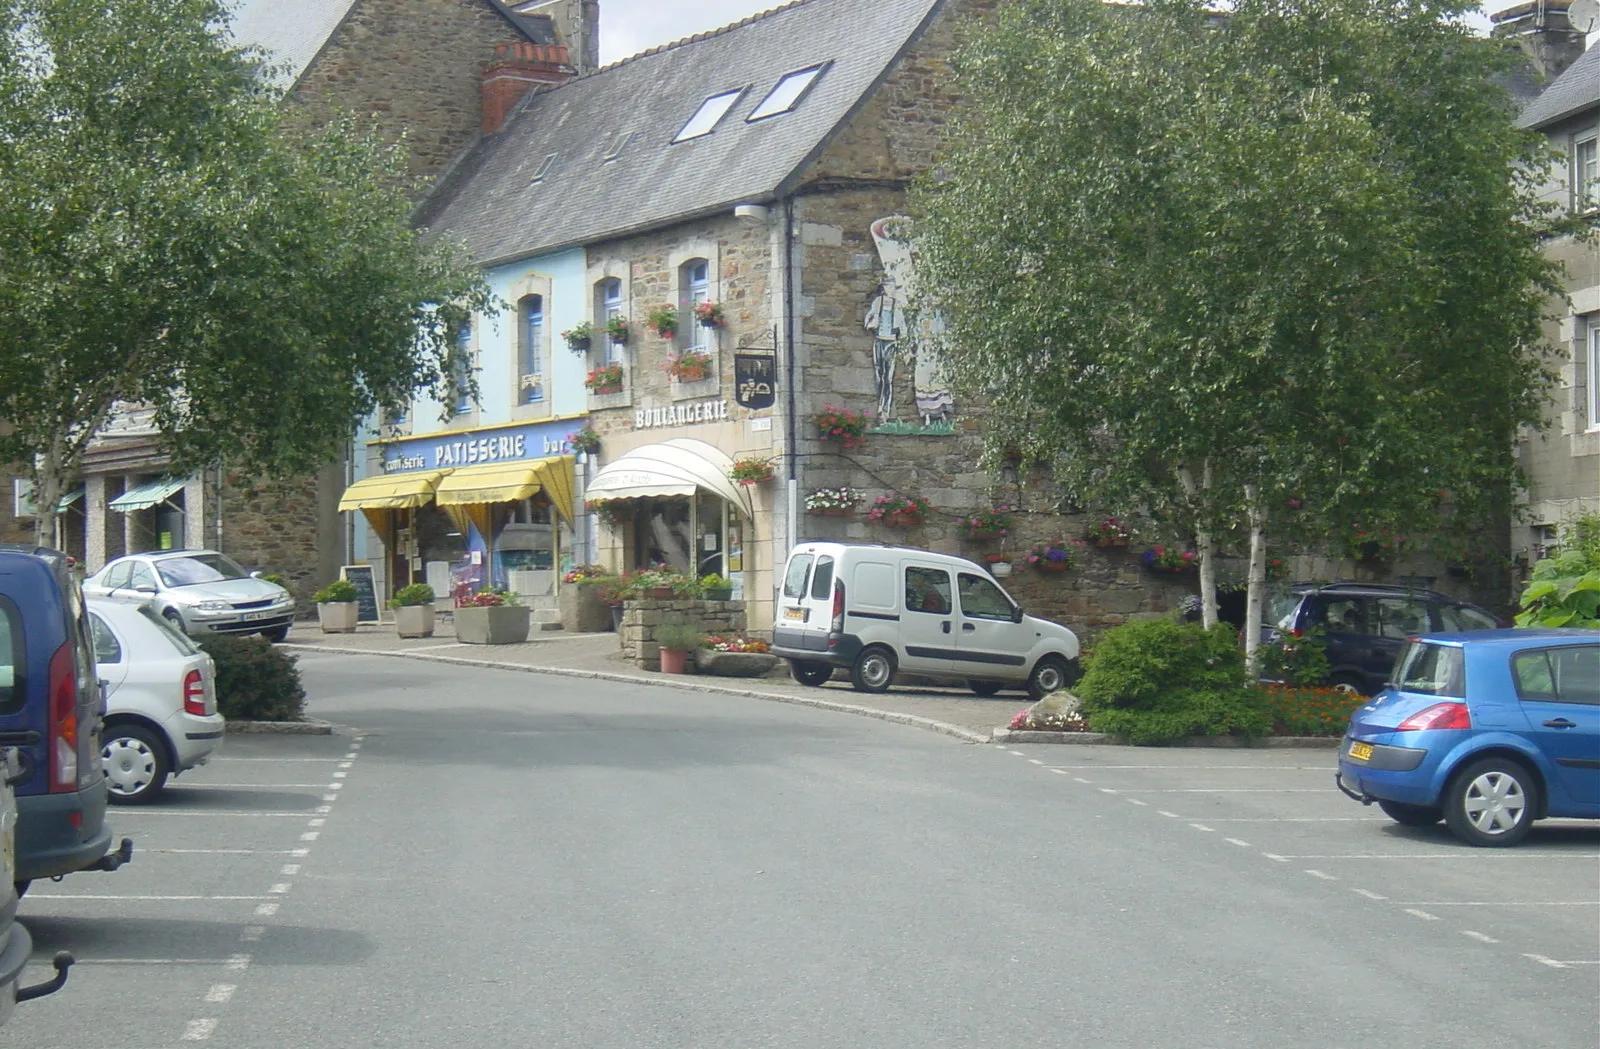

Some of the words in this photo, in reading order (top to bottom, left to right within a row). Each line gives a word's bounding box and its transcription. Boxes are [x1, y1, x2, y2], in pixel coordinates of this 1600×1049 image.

[635, 399, 729, 428] BOULANGERIE
[435, 434, 526, 466] PATISSERIE
[543, 435, 566, 454] bar
